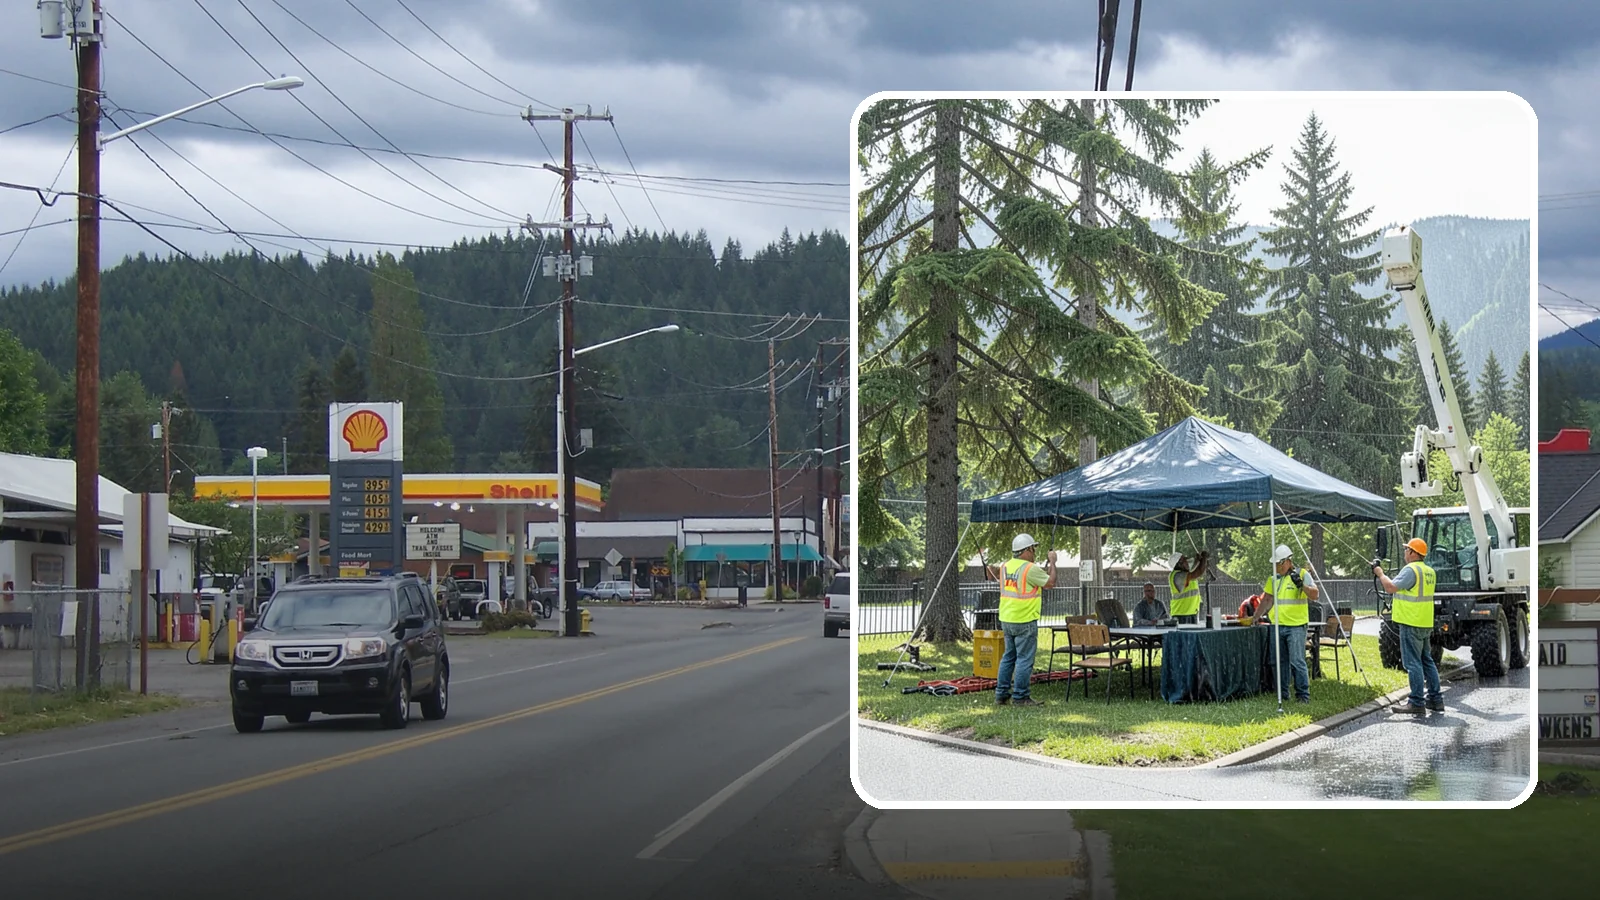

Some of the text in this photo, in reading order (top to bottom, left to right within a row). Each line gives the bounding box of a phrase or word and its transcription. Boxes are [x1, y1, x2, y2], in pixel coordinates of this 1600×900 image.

[366, 480, 383, 490] 395
[490, 484, 547, 499] Shell
[366, 494, 383, 504] 405
[366, 508, 383, 518] 415
[366, 522, 383, 532] 429
